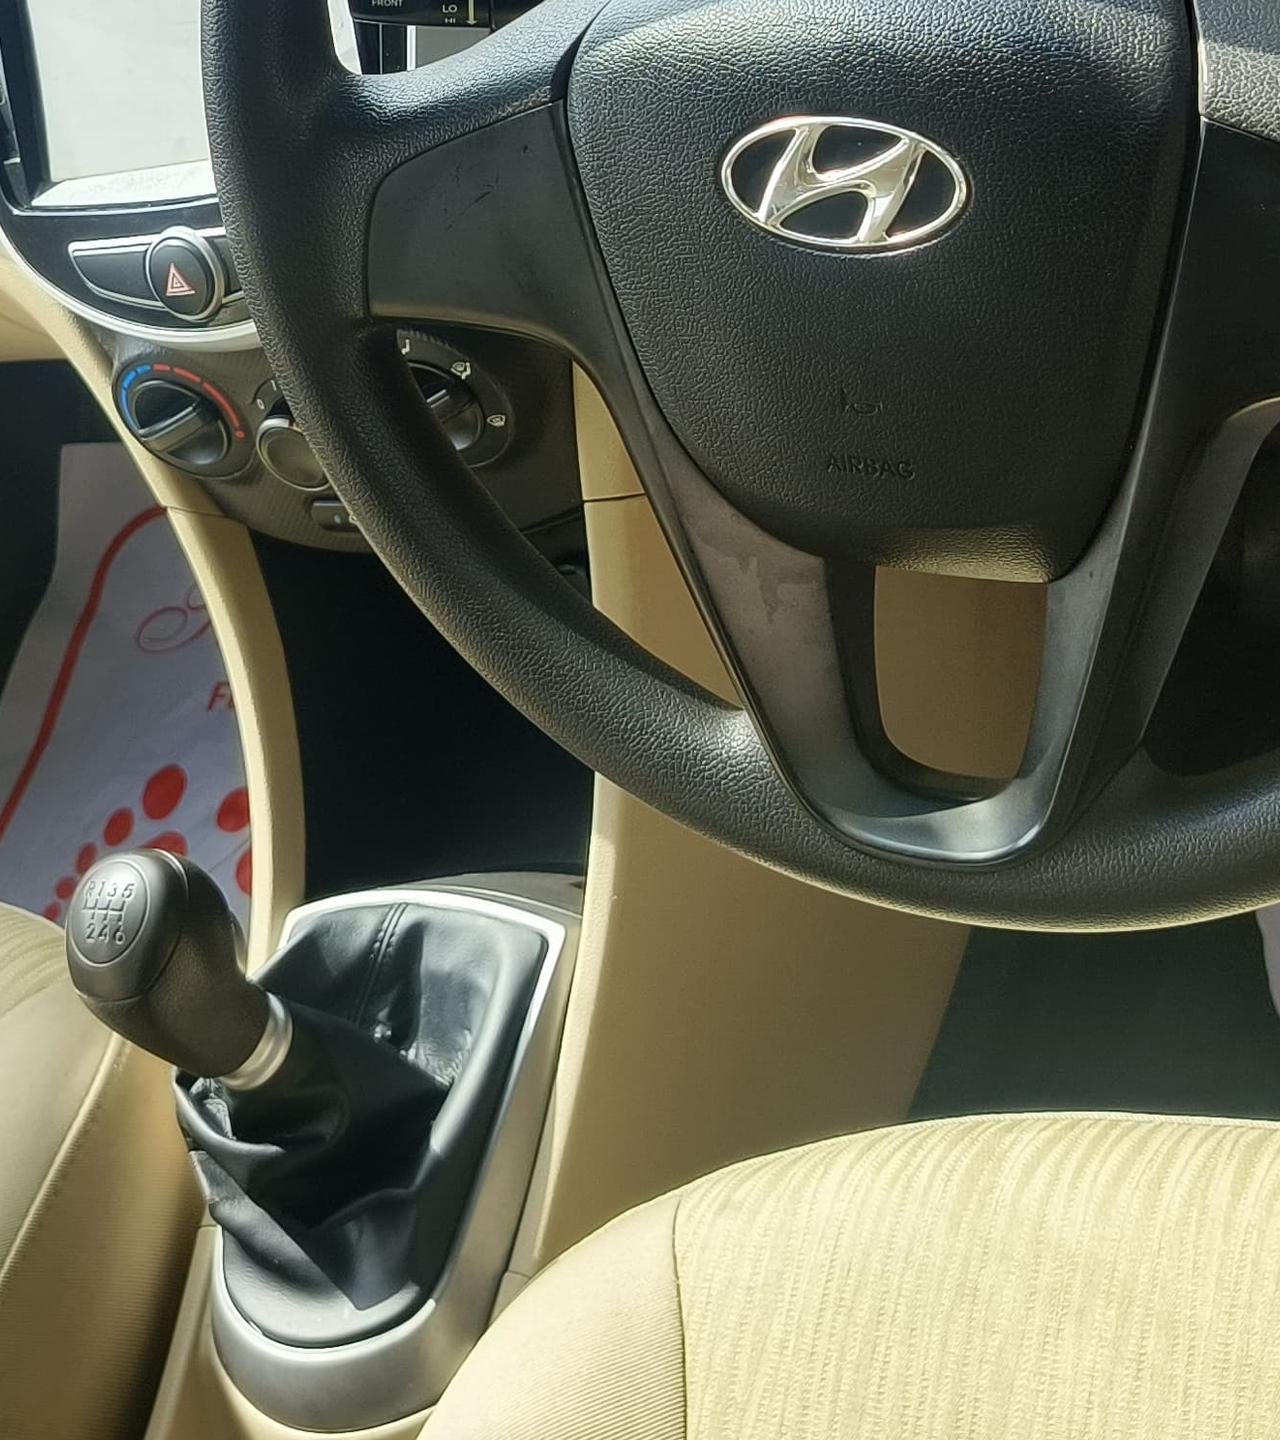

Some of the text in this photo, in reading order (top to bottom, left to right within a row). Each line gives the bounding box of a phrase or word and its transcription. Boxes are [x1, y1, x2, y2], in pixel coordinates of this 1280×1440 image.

[442, 4, 458, 14] LO
[827, 454, 915, 481] AIRBAG
[113, 925, 125, 944] 6
